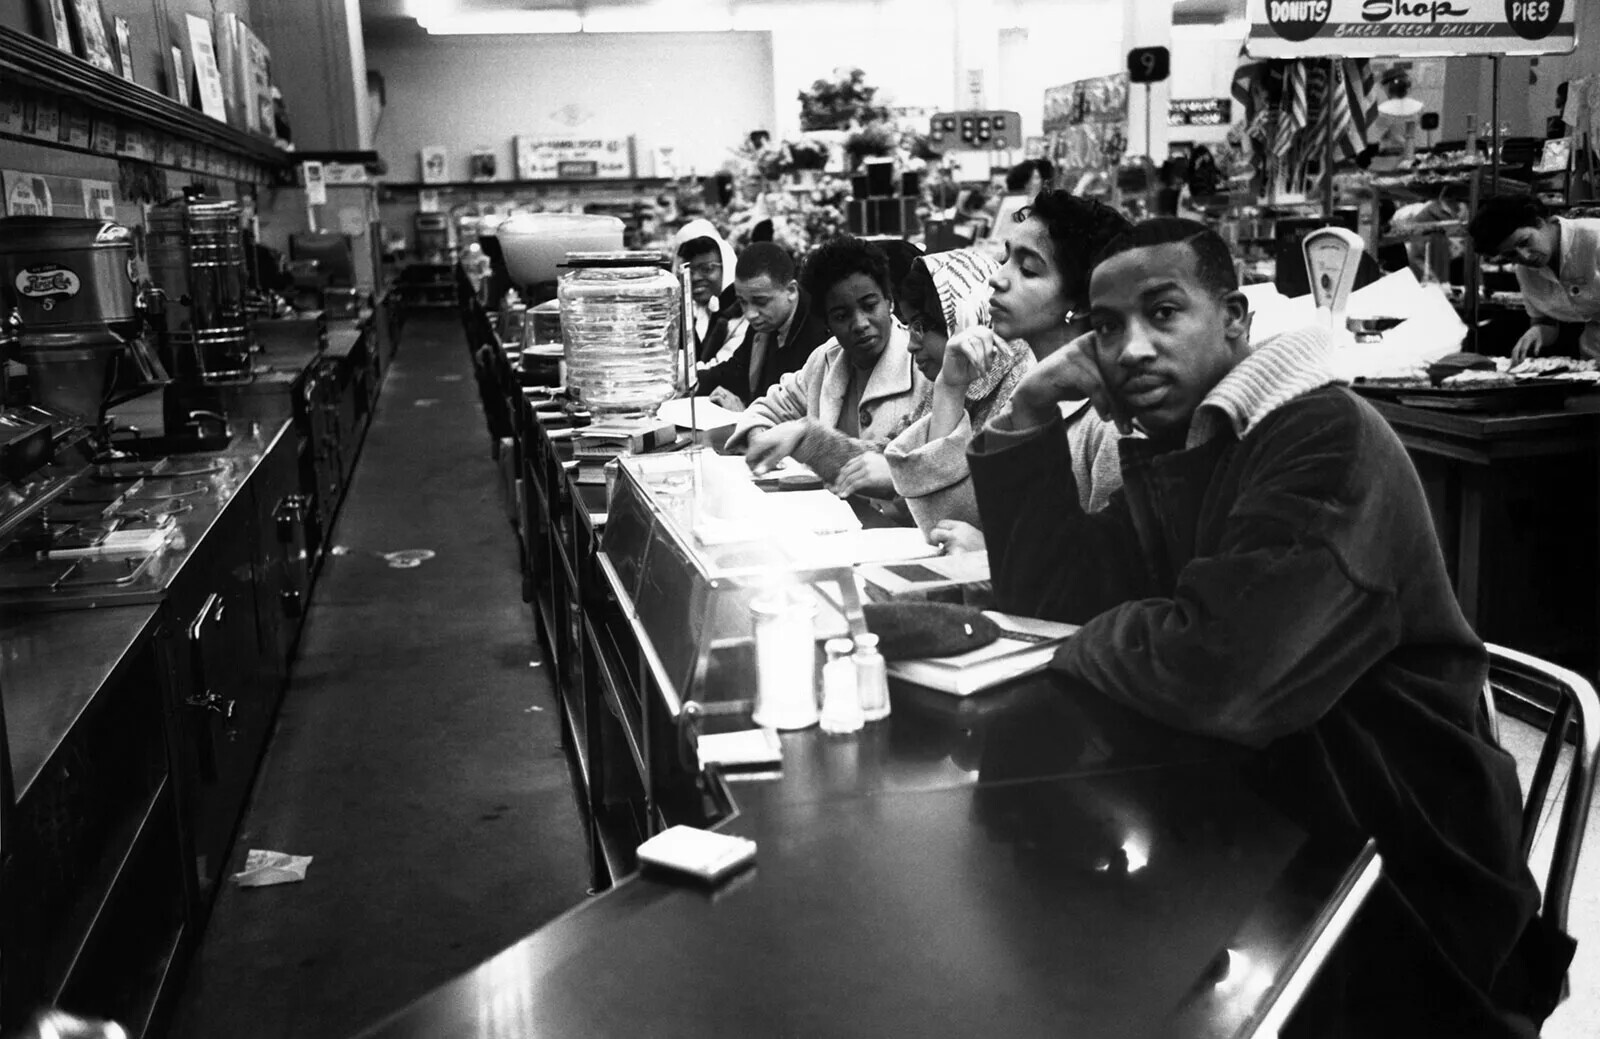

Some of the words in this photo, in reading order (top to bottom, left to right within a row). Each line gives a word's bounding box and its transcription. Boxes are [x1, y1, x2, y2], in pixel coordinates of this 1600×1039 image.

[1270, 0, 1328, 23] DONUTS
[1361, 0, 1470, 23] Shop
[1512, 1, 1550, 22] PIES
[1334, 23, 1381, 37] BAKED
[1387, 23, 1434, 36] FRESH
[1140, 53, 1155, 76] 9
